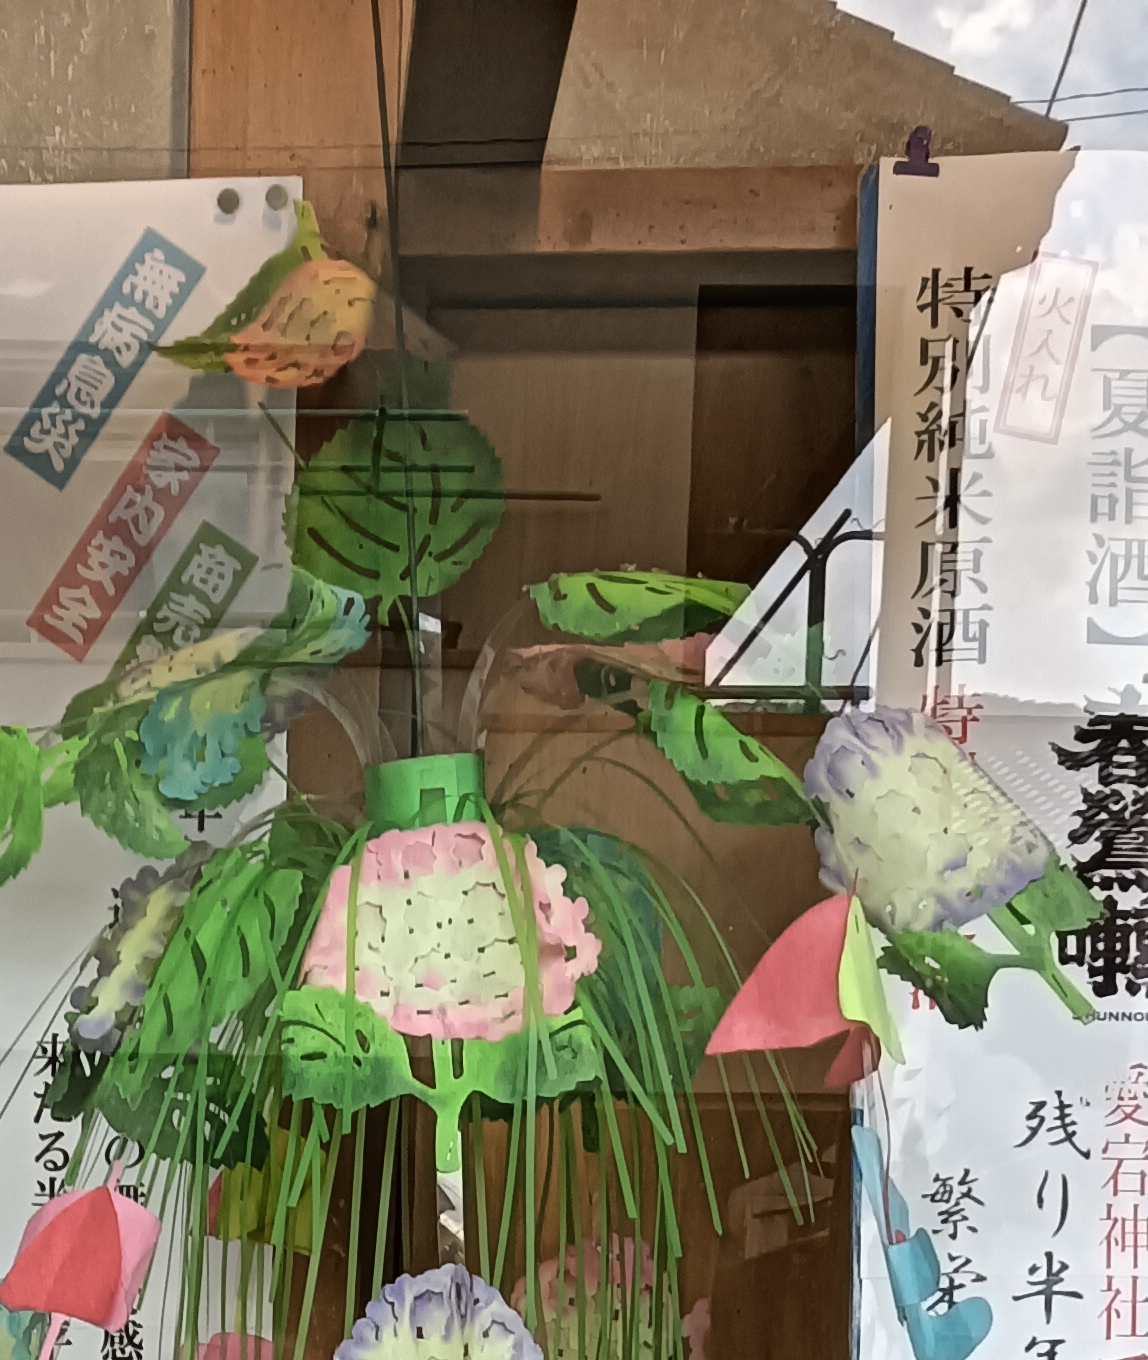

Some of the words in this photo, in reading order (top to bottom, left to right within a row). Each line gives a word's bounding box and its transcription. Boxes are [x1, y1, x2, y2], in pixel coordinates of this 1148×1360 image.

[1014, 286, 1076, 403] 火入れ
[43, 430, 202, 646] 家内安全
[909, 265, 996, 669] 特別純米原酒
